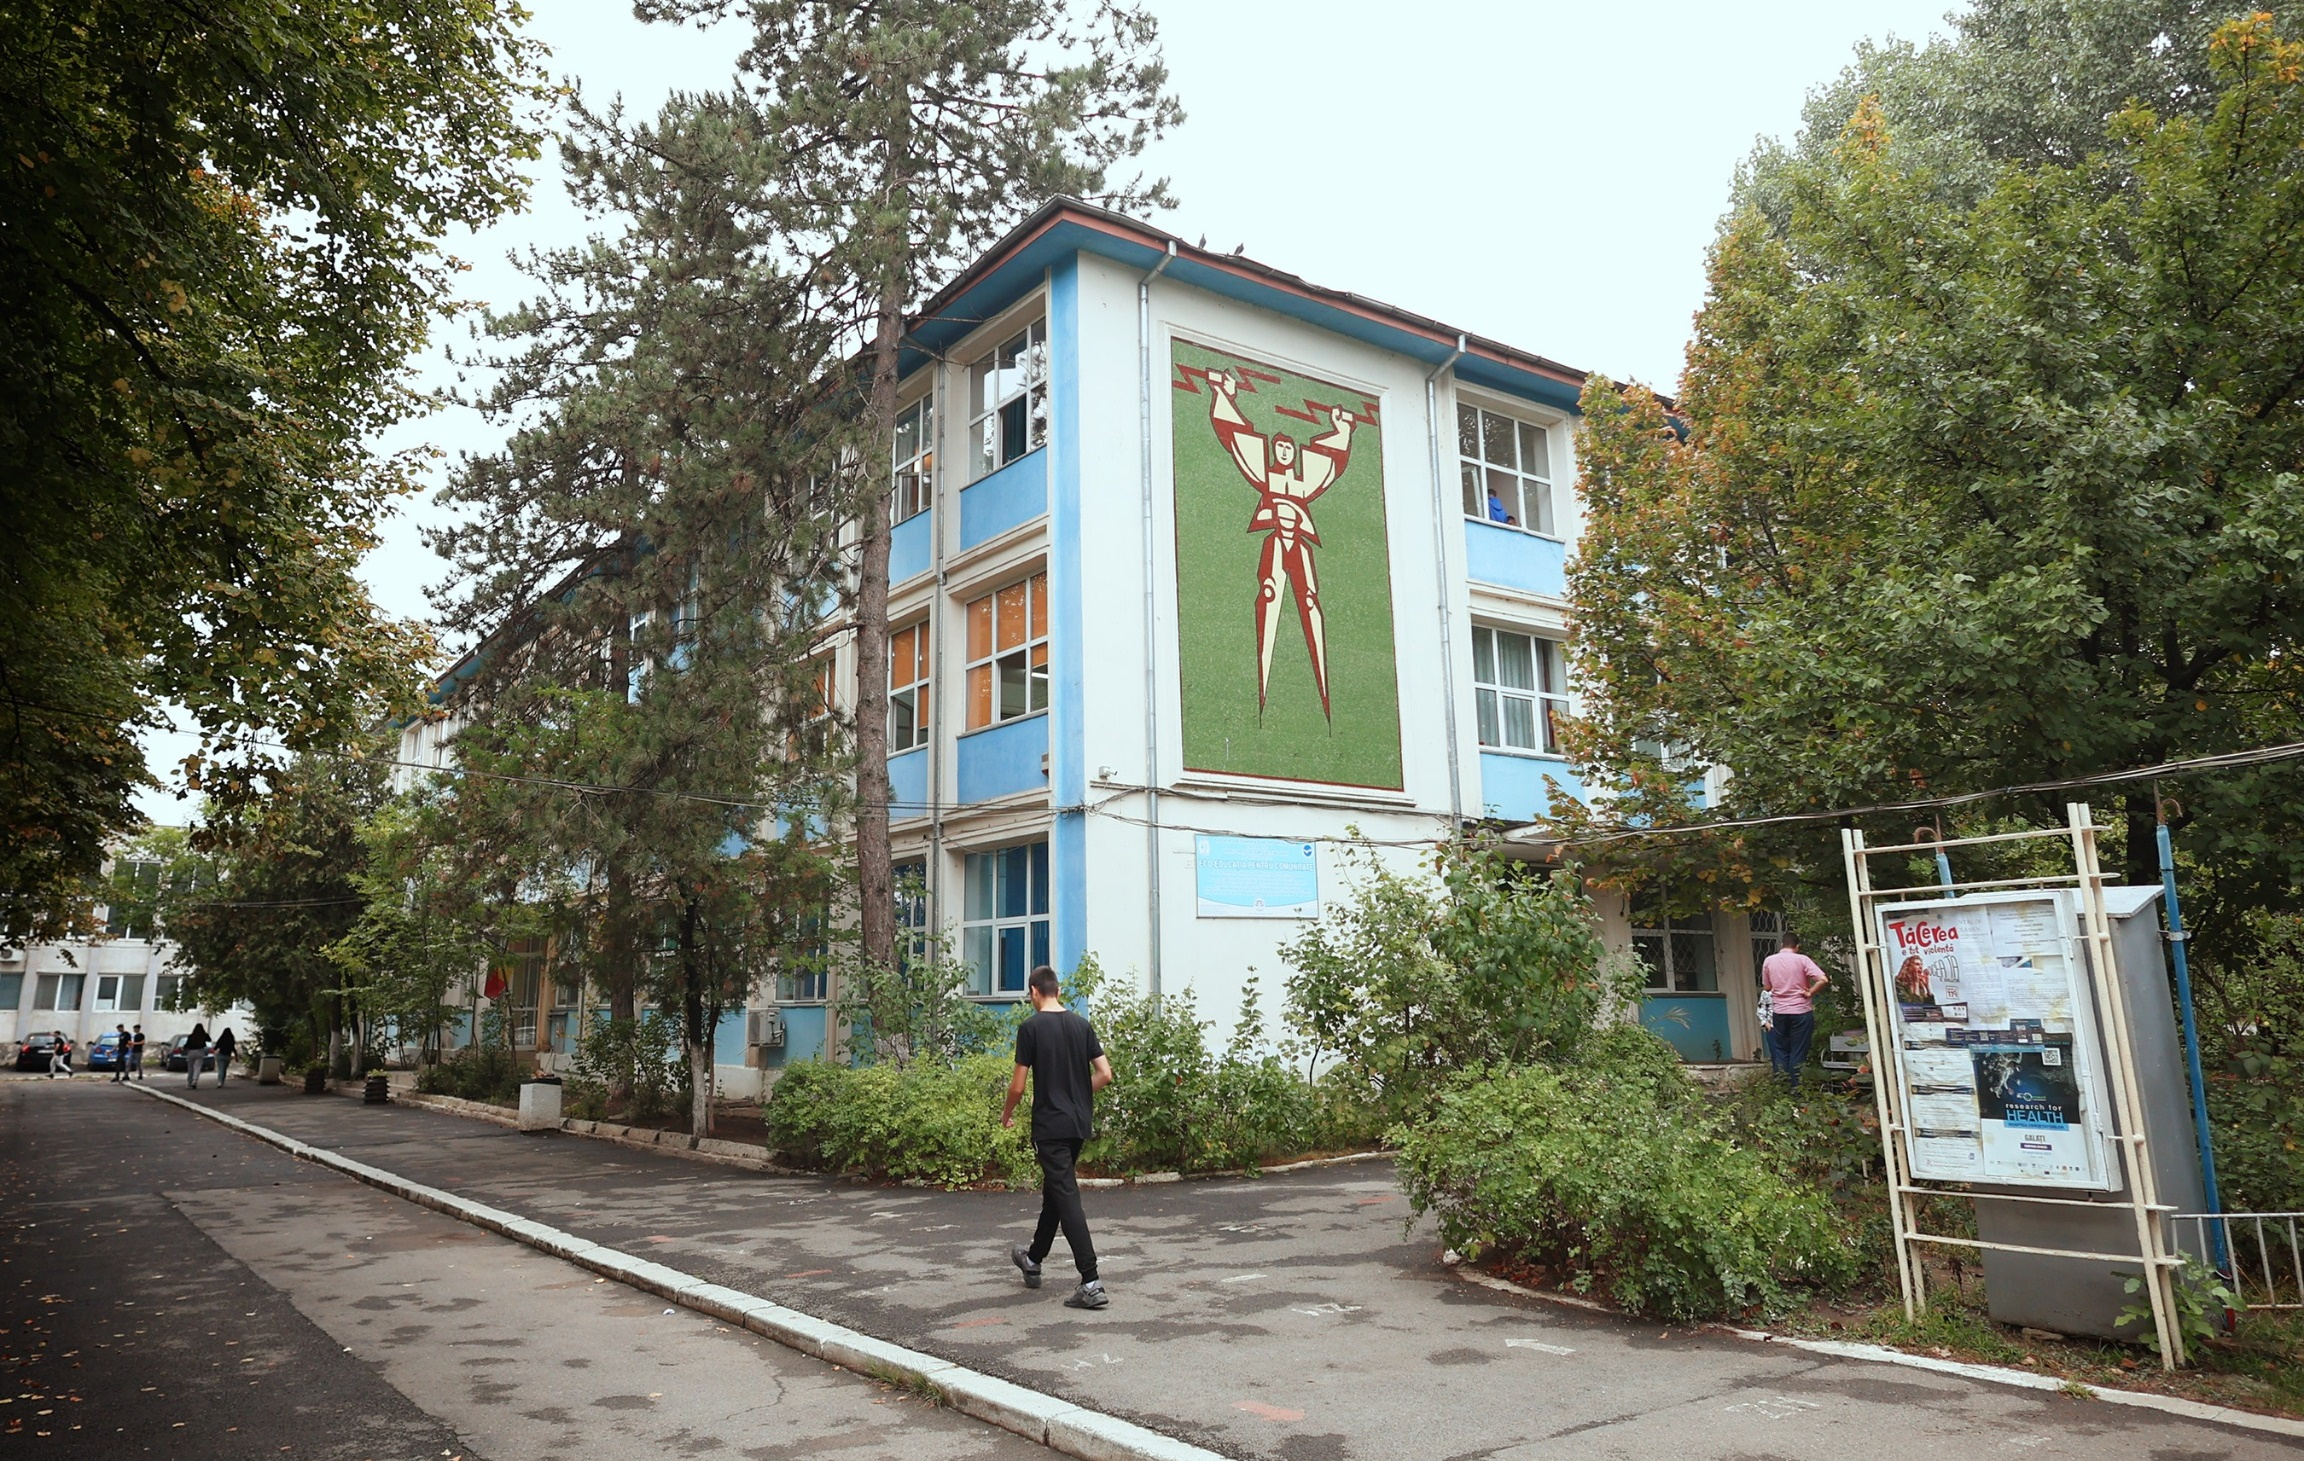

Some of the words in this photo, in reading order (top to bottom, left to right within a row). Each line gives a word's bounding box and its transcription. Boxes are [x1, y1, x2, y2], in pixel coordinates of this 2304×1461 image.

[1248, 861, 1273, 870] PENTRU
[1275, 862, 1314, 872] COMUNITATE
[1909, 945, 1920, 955] tot
[2006, 1109, 2064, 1124] HEALTH
